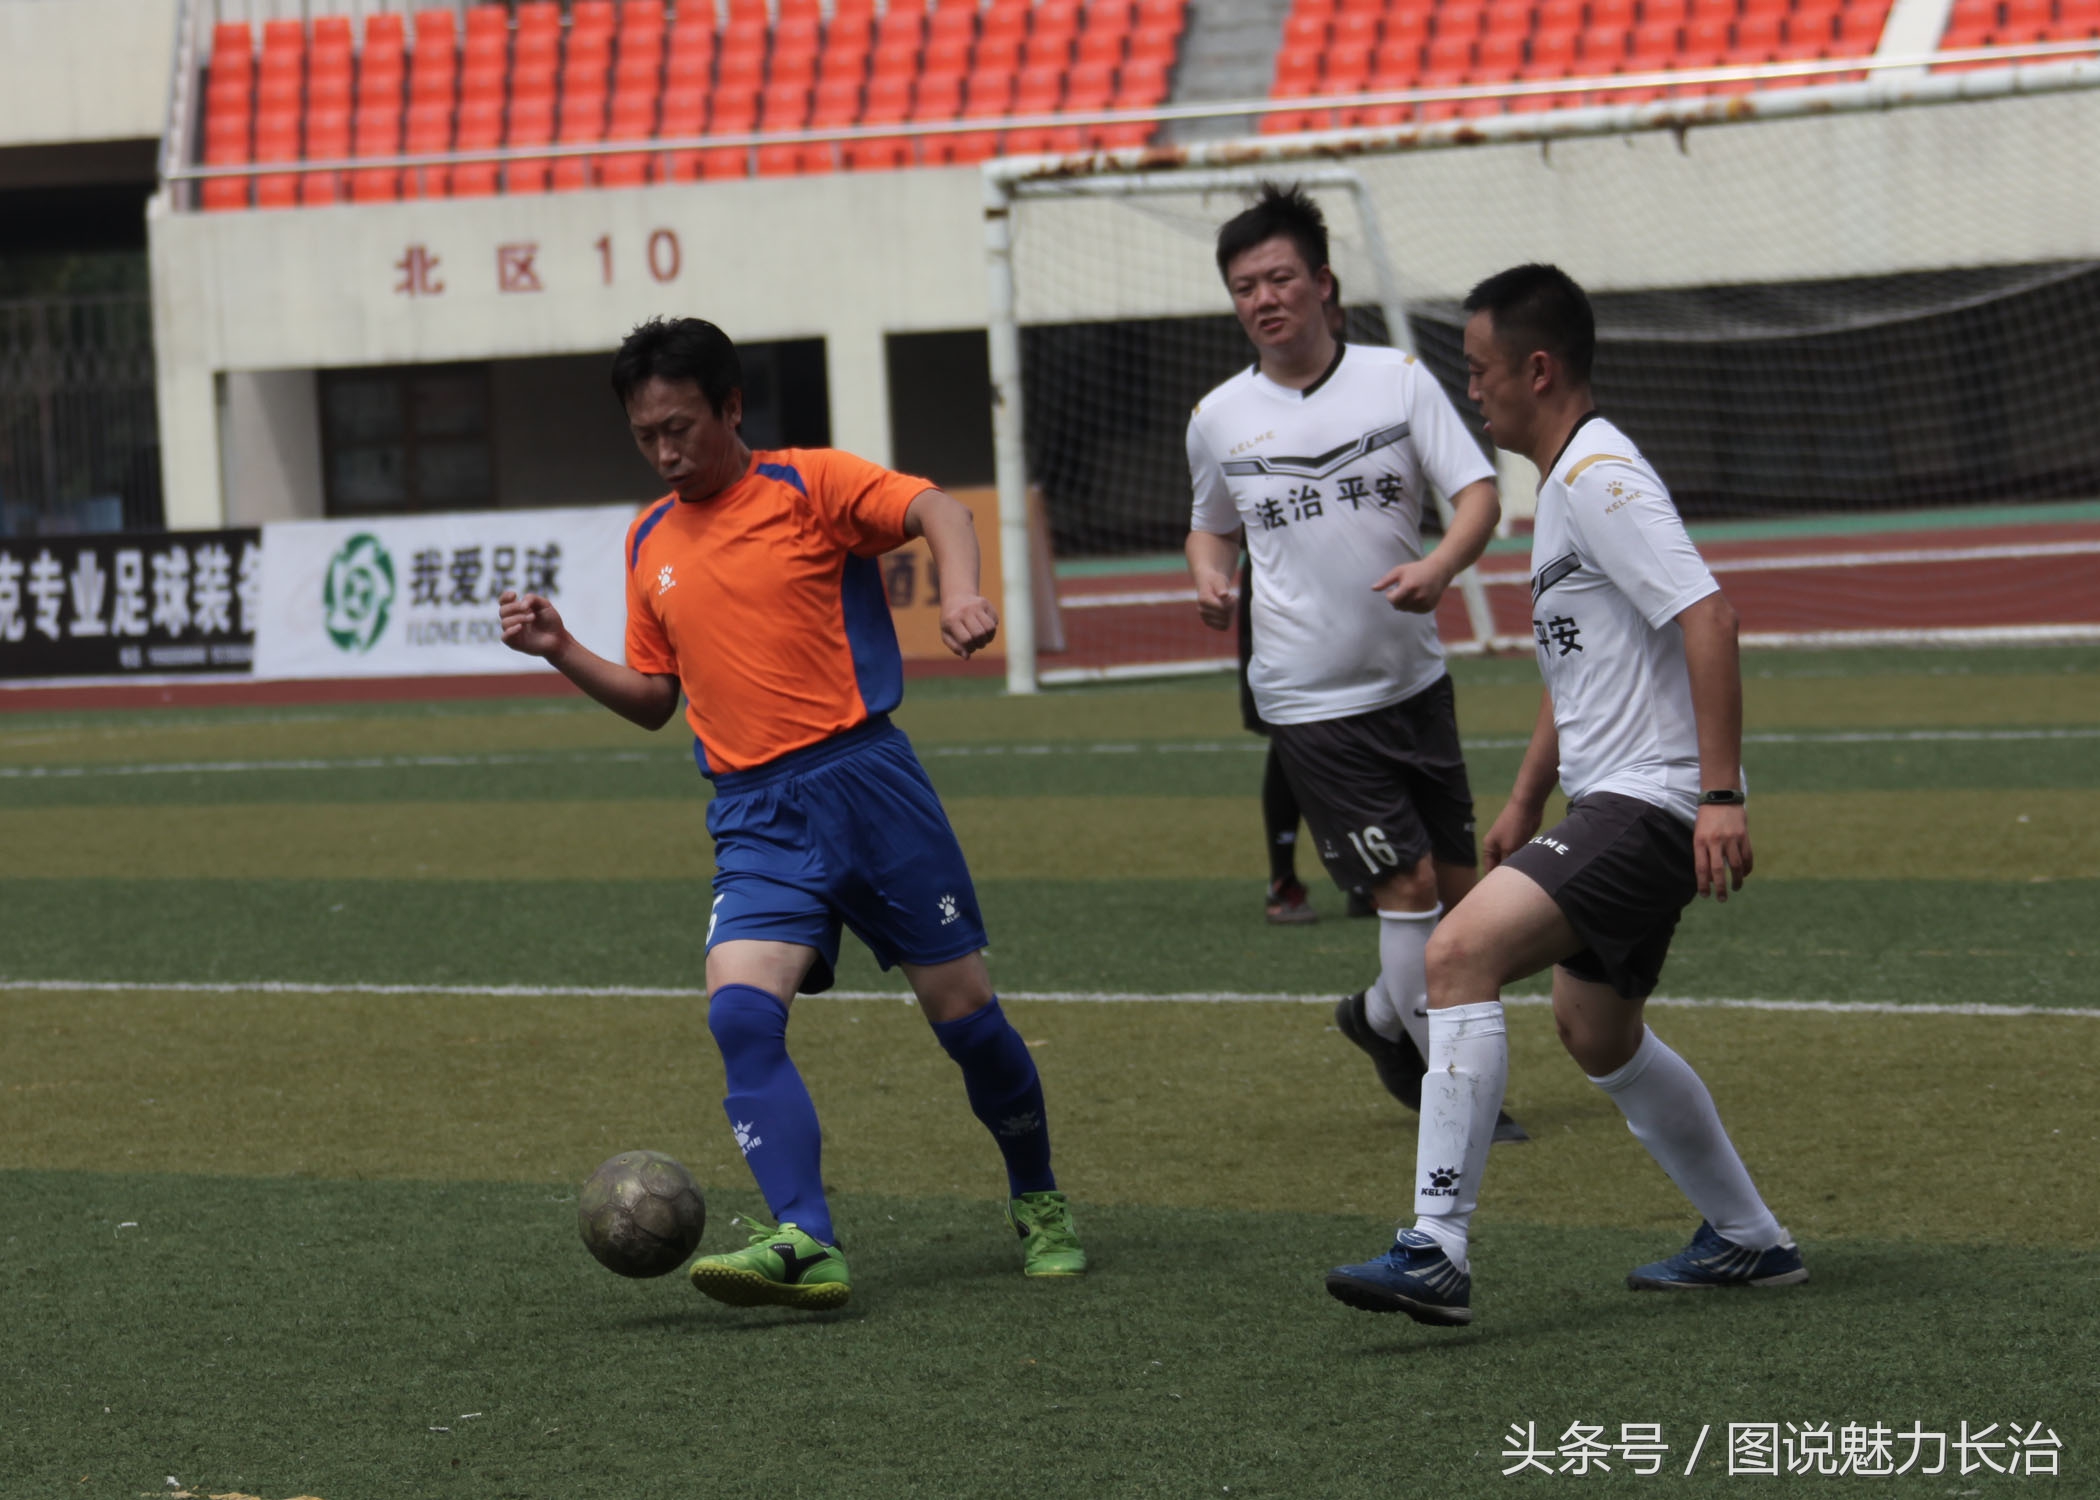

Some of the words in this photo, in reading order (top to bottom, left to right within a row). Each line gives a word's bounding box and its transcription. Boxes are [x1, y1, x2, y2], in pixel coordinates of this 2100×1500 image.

[595, 228, 681, 286] 10
[1255, 485, 1324, 531] 法治
[1337, 473, 1403, 511] 平安
[1604, 490, 1642, 514] KELME
[409, 542, 560, 607] 我爱足球
[1347, 825, 1399, 875] 16
[1421, 1187, 1460, 1197] KELME
